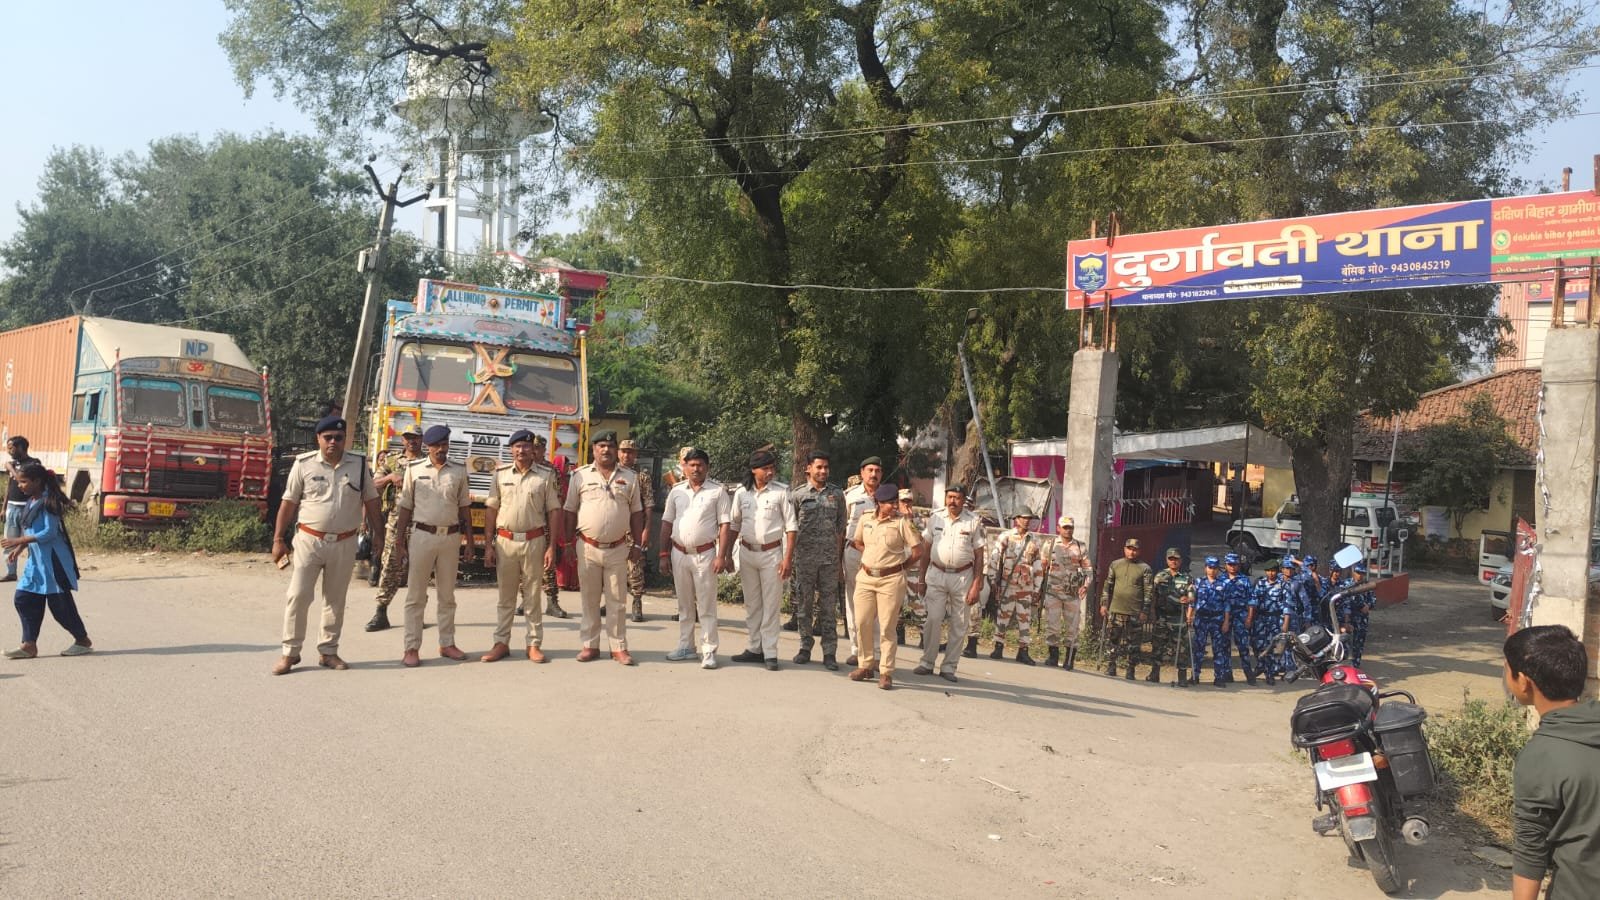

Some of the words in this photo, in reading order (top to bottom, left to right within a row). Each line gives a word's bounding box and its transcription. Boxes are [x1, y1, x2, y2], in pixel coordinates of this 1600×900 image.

[1493, 206, 1524, 221] दक्षिण
[1525, 203, 1556, 219] बिहार
[1558, 198, 1596, 218] ग्रामीण
[1111, 224, 1323, 292] दुर्गावती
[1335, 219, 1485, 258] थाना
[1391, 259, 1451, 273] 9430845219
[504, 297, 539, 313] PERMIT
[185, 340, 208, 356] NP
[472, 434, 501, 446] TATA
